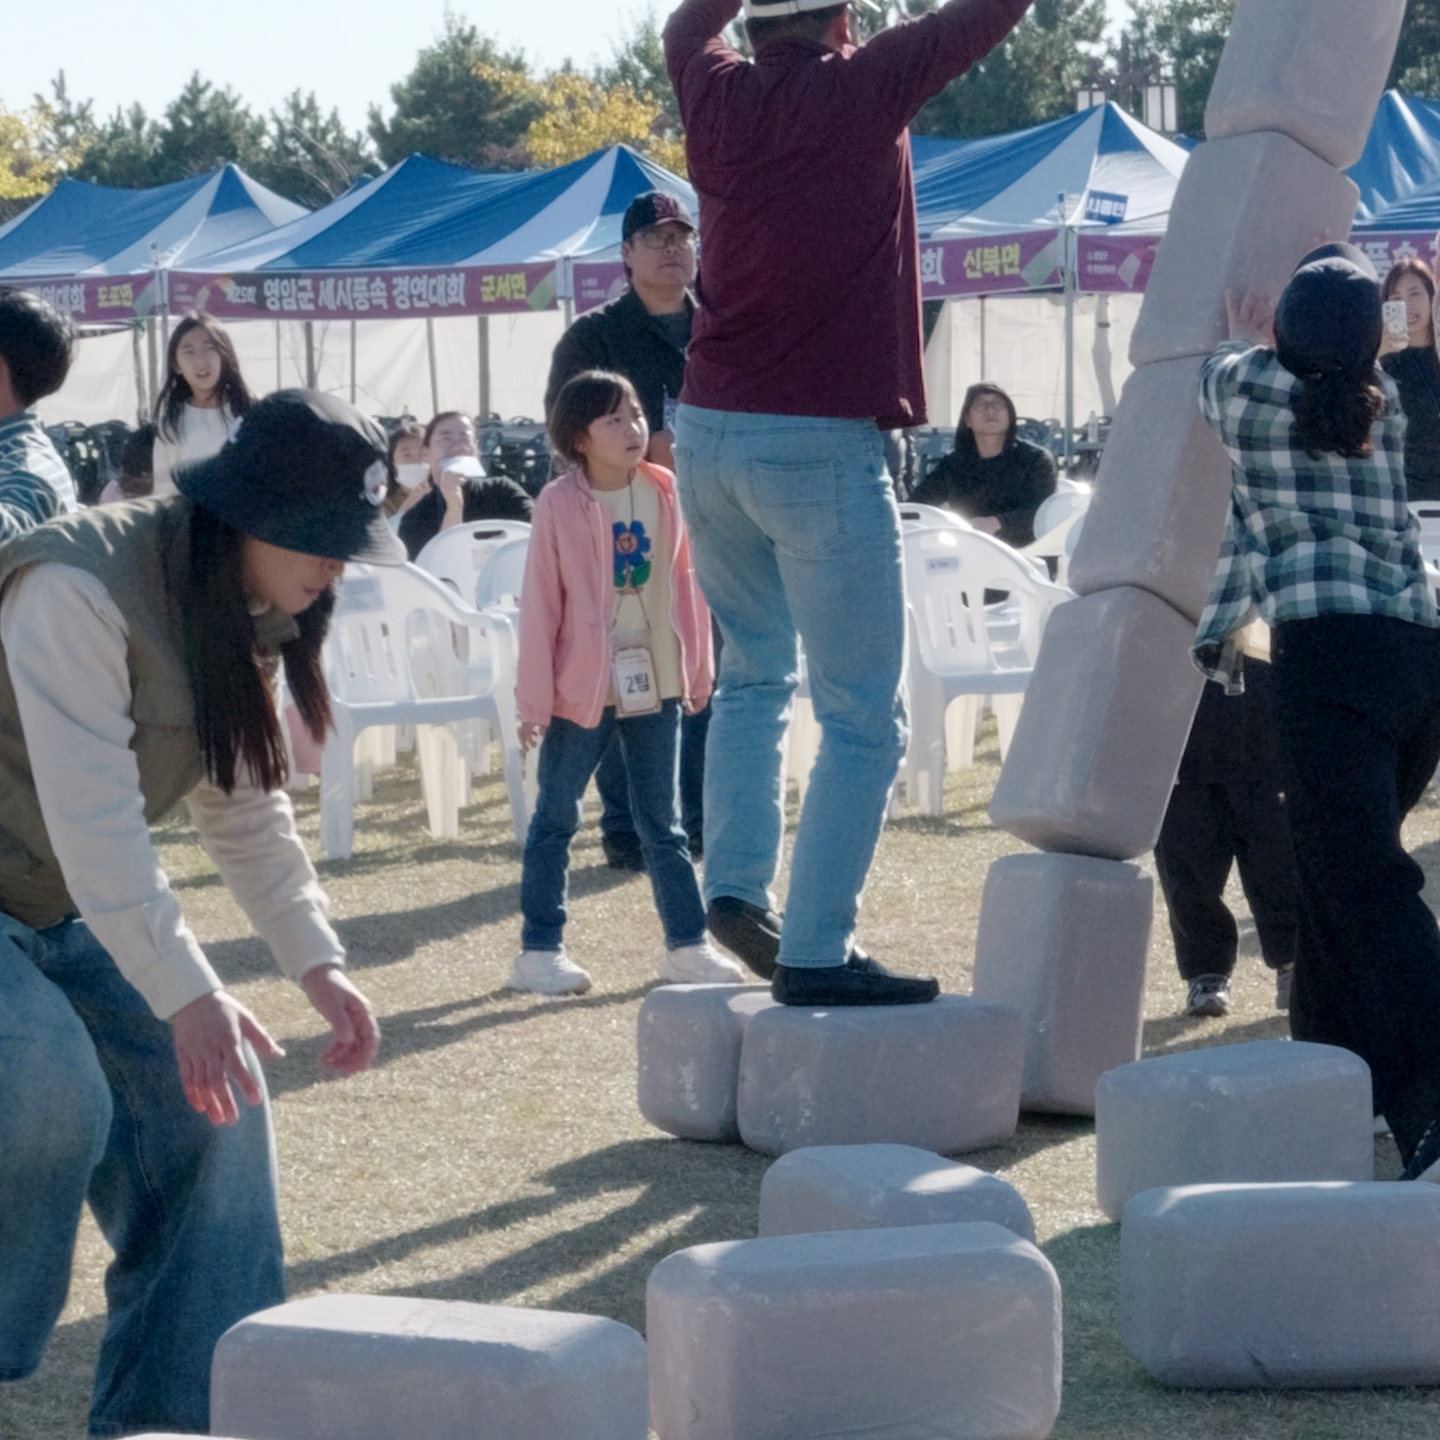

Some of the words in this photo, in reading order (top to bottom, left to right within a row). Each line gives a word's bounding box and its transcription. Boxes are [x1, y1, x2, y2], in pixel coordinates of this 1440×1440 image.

[962, 242, 1021, 280] 신북면
[262, 277, 316, 312] 영암군
[317, 274, 389, 312] 세시풍속
[391, 271, 467, 310] 경연대회
[479, 271, 527, 302] 군서면
